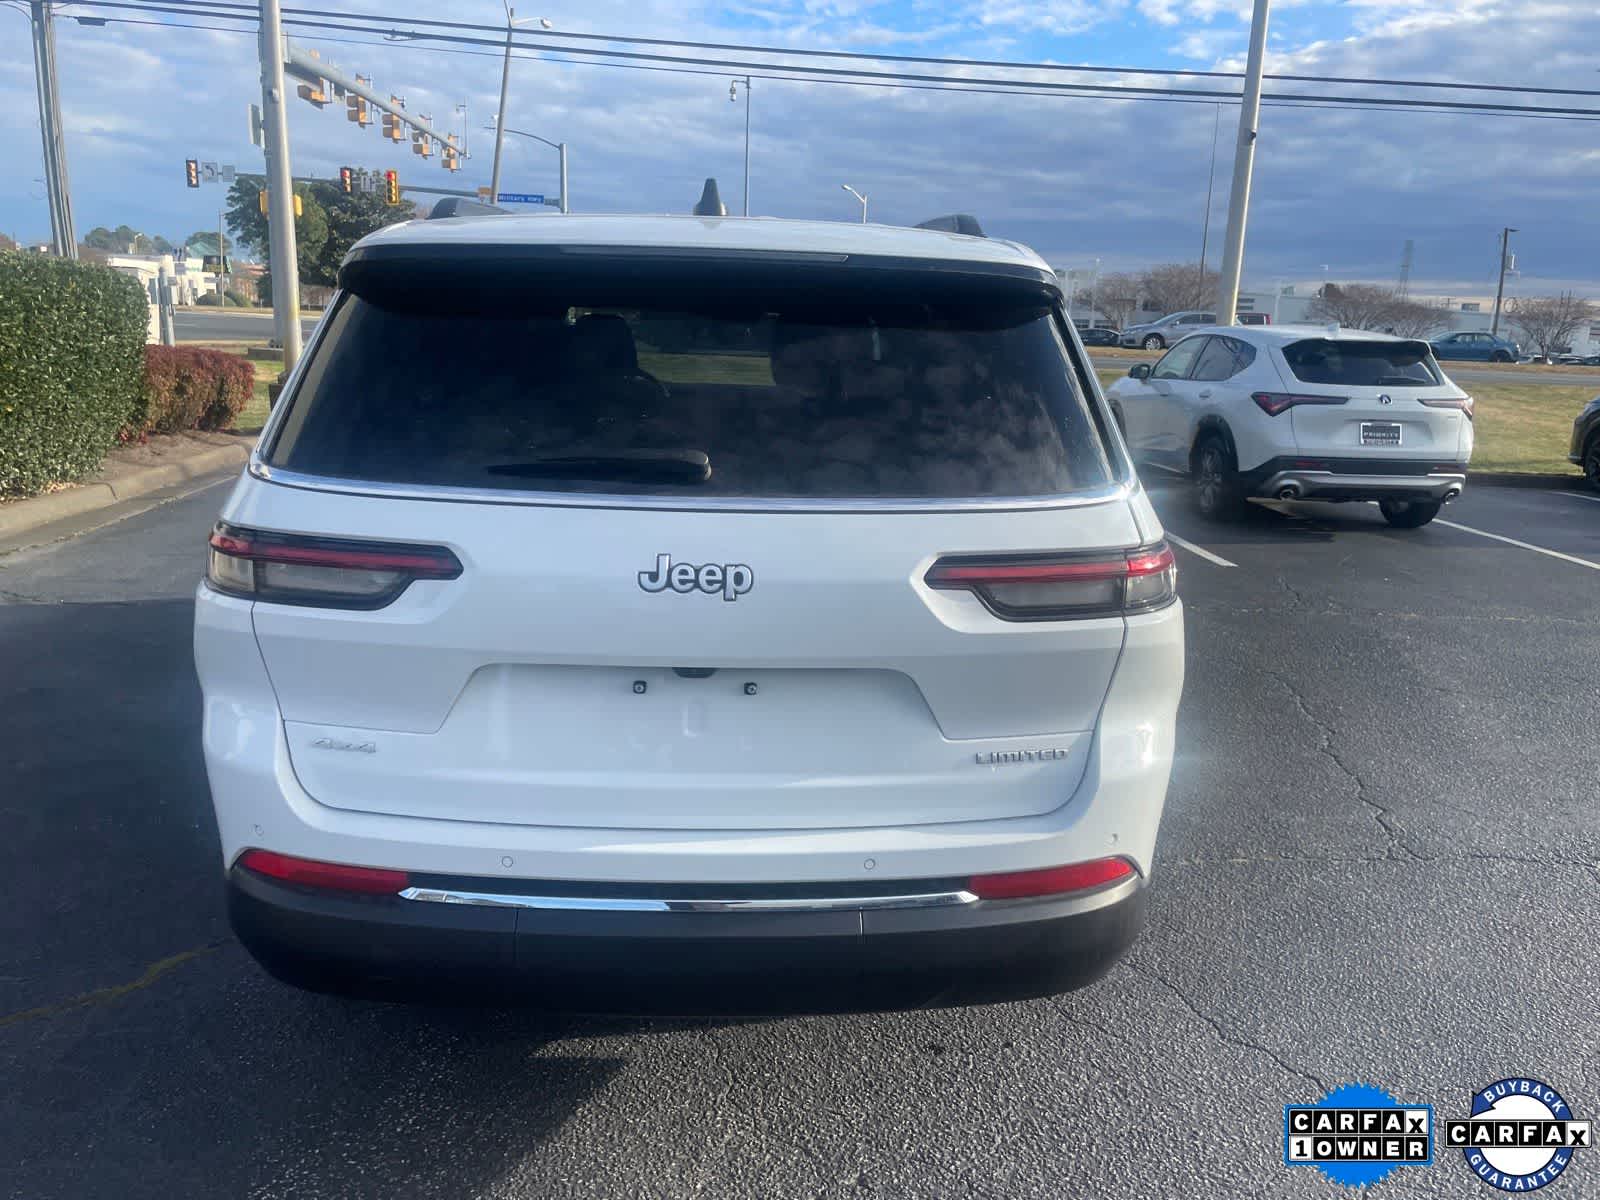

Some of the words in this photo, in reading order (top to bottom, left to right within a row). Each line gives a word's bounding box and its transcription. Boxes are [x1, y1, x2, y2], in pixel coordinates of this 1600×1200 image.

[498, 194, 525, 203] Military
[638, 553, 754, 602] Jeep
[975, 748, 1068, 765] LIMITED
